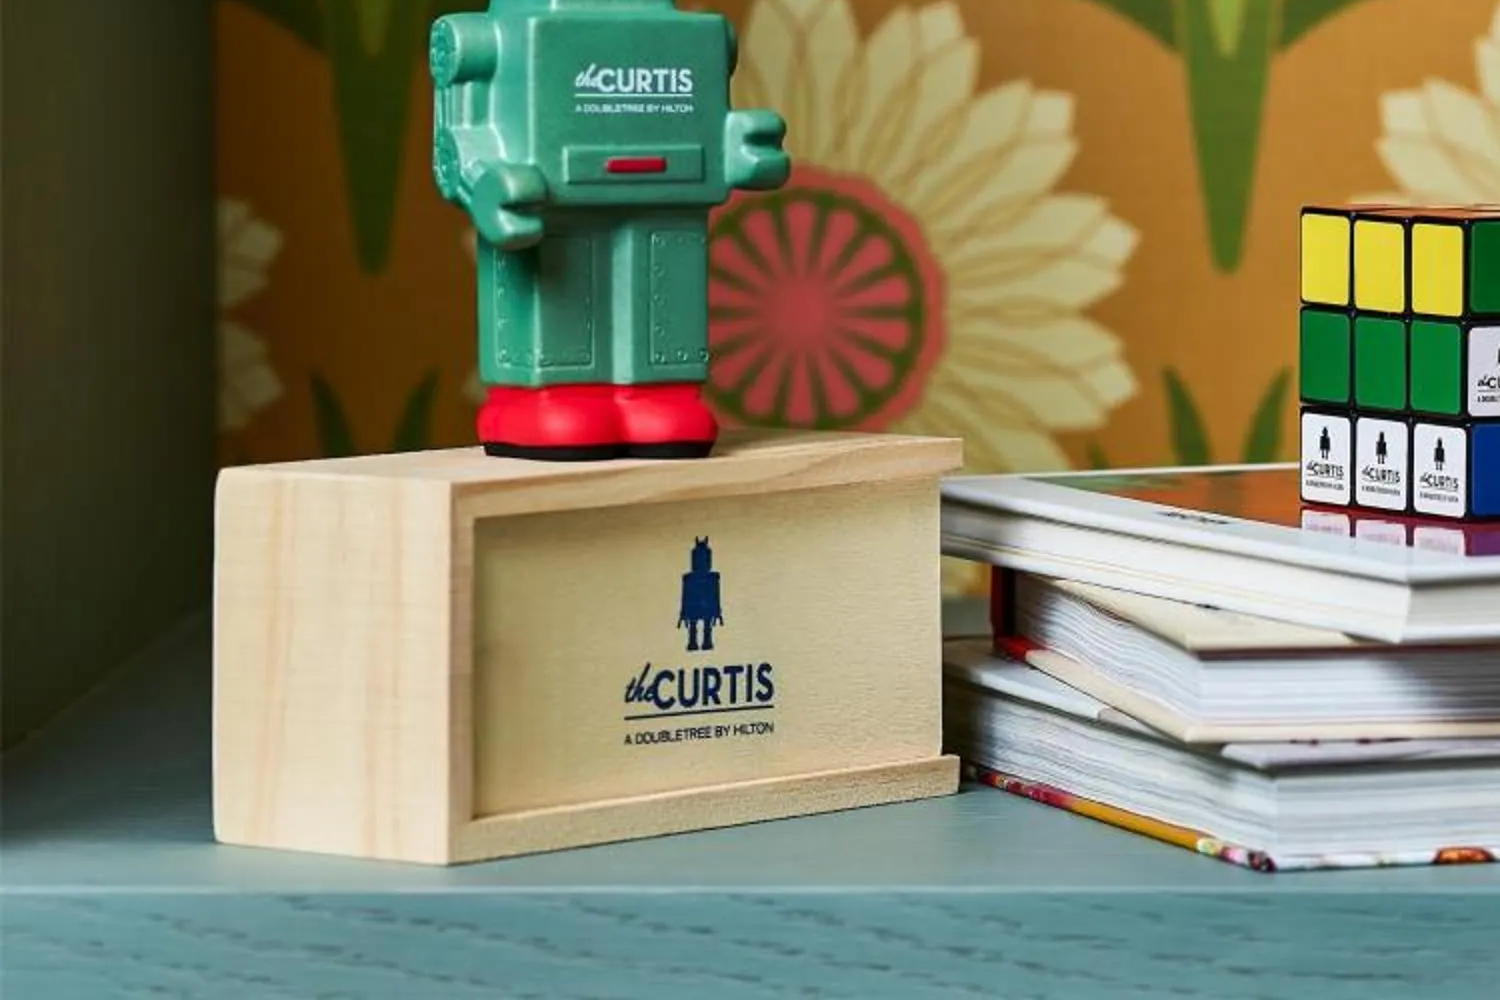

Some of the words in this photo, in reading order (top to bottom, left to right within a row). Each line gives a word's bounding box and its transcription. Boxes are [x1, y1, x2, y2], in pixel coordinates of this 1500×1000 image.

[624, 734, 633, 745] A
[635, 726, 711, 744] DOUBLETREE
[715, 725, 731, 738] BY
[734, 722, 774, 736] HILTON
